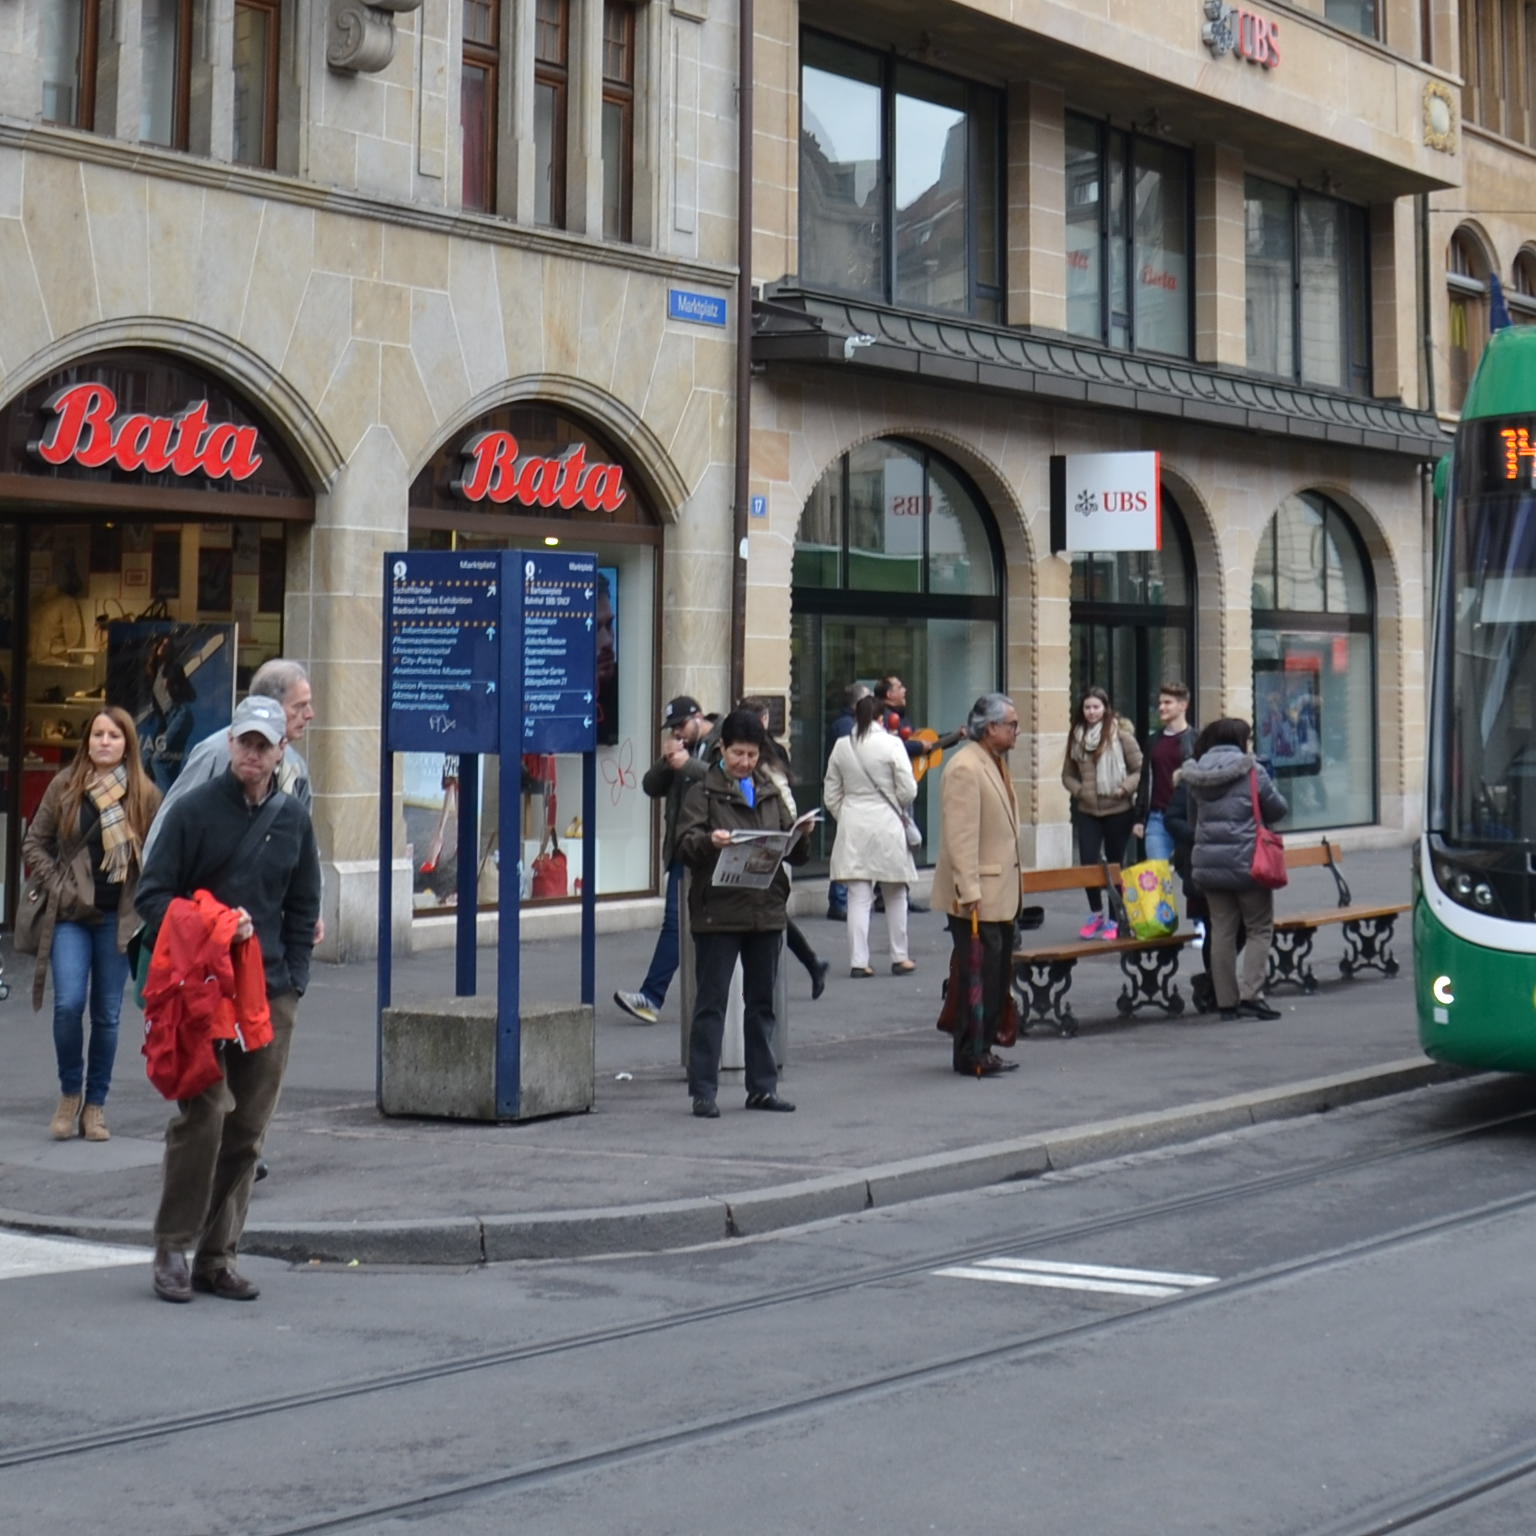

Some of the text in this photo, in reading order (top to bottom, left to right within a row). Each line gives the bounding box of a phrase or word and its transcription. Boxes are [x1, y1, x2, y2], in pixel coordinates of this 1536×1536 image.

[1232, 7, 1281, 68] UBS
[677, 294, 720, 321] Marktplatz
[38, 382, 263, 482] Bata
[462, 430, 627, 513] Bata
[754, 499, 763, 514] 17
[1103, 491, 1148, 513] UBS
